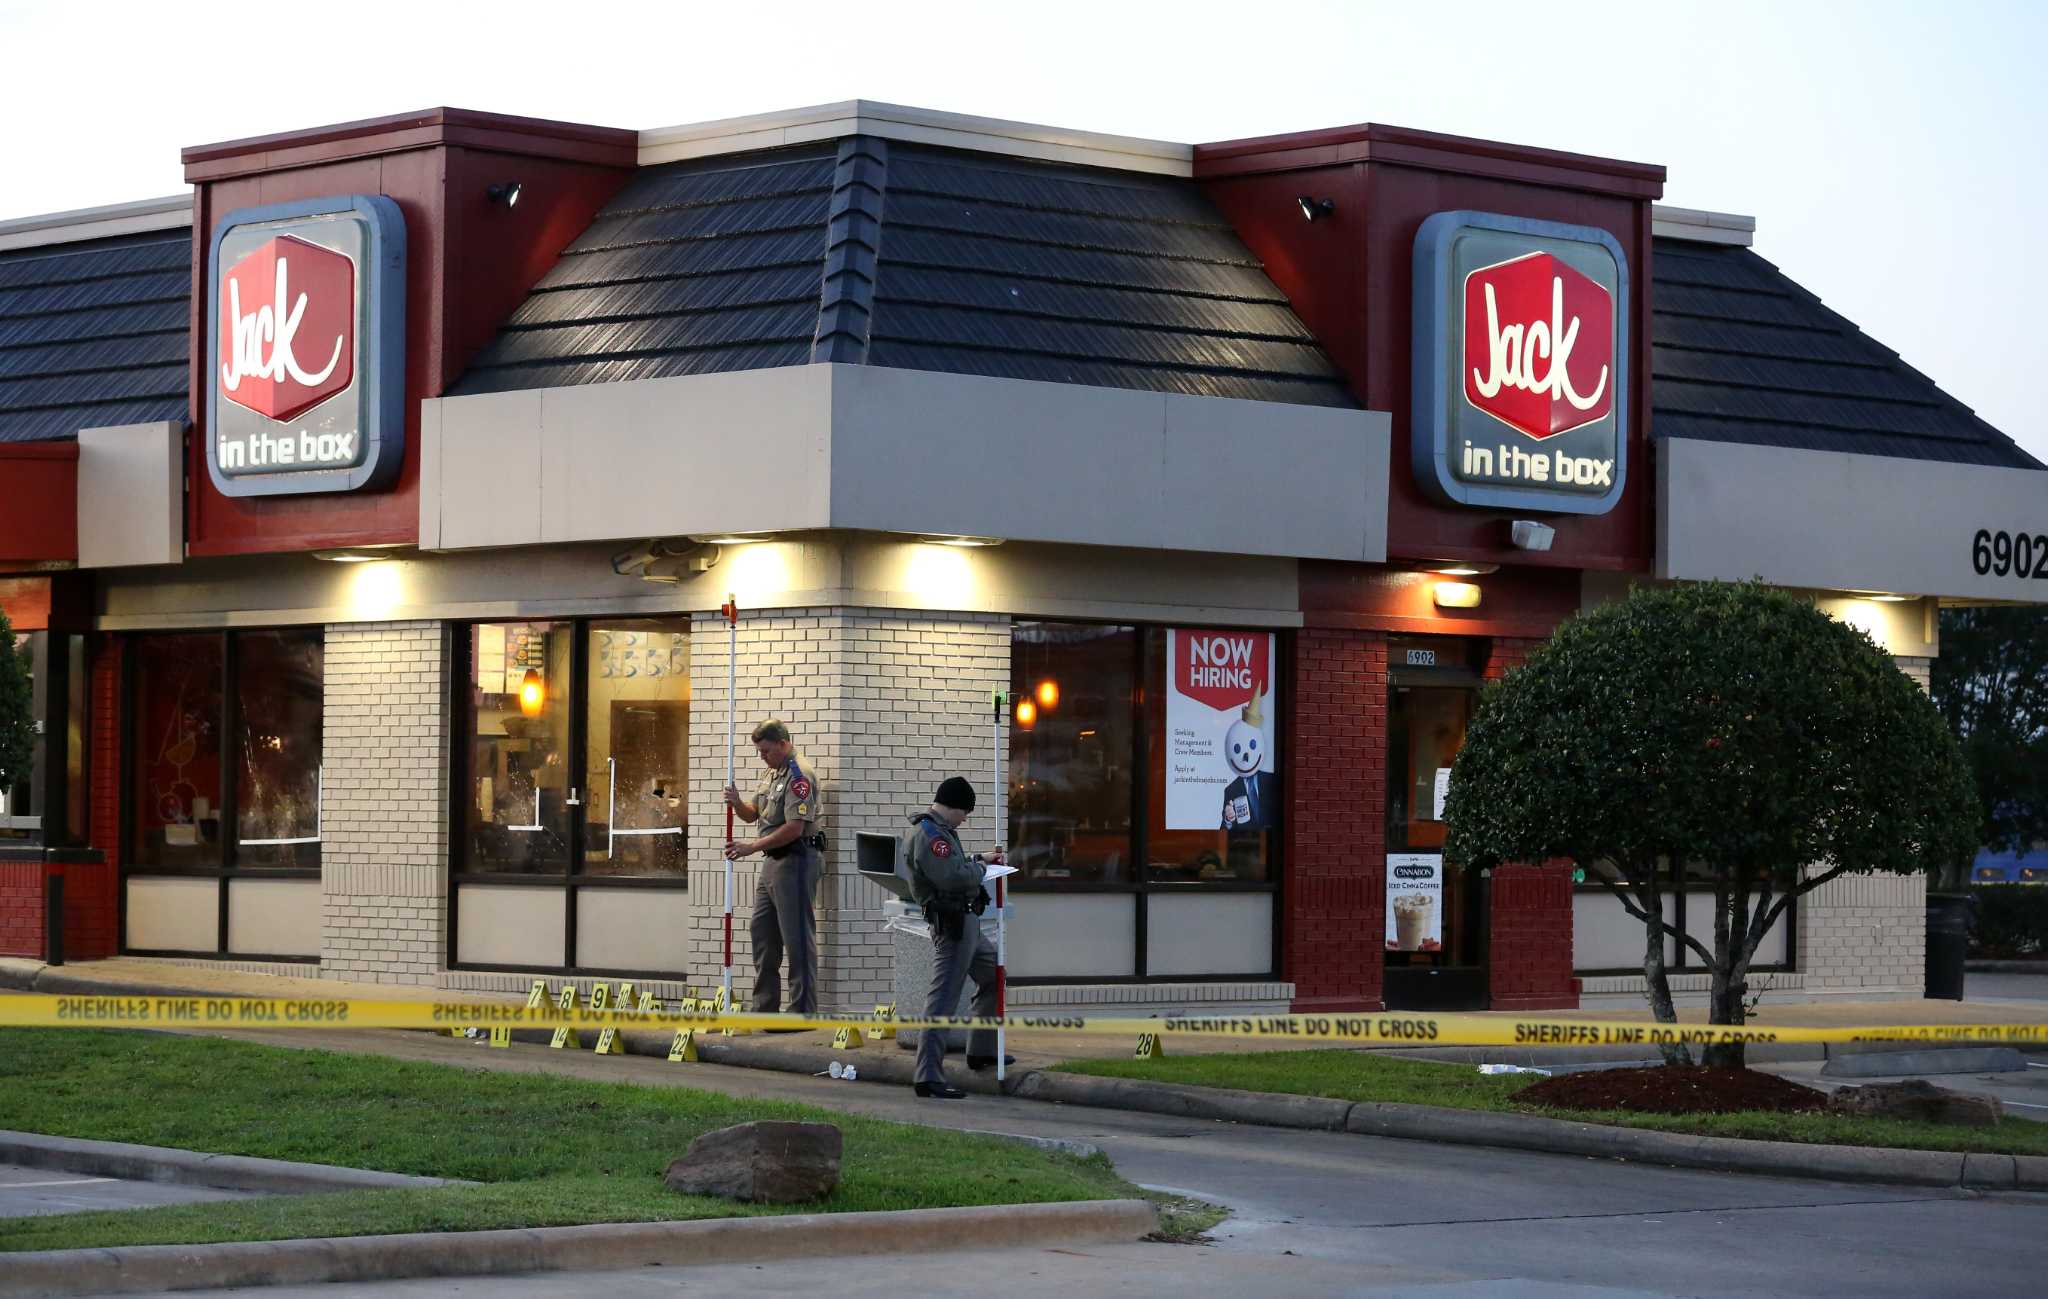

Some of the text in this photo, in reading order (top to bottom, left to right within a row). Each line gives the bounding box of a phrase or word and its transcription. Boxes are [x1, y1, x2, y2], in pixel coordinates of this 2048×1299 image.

[222, 257, 343, 391] Jack
[1474, 276, 1608, 410] Jack
[220, 430, 352, 468] in the box
[1463, 440, 1611, 486] in the box
[1972, 529, 2048, 579] 6902
[1190, 635, 1254, 667] NOW
[1408, 651, 1434, 664] 6902
[1190, 666, 1252, 689] HIRING
[560, 990, 571, 1008] 8
[592, 987, 604, 1009] 9
[1259, 1019, 1299, 1035] LINE
[1306, 1019, 1330, 1037] DO
[1337, 1019, 1373, 1038] NOT
[1379, 1019, 1438, 1040] CROSS
[1515, 1023, 1600, 1044] SHERIFFS
[671, 1032, 689, 1055] 22
[1136, 1033, 1153, 1055] 28
